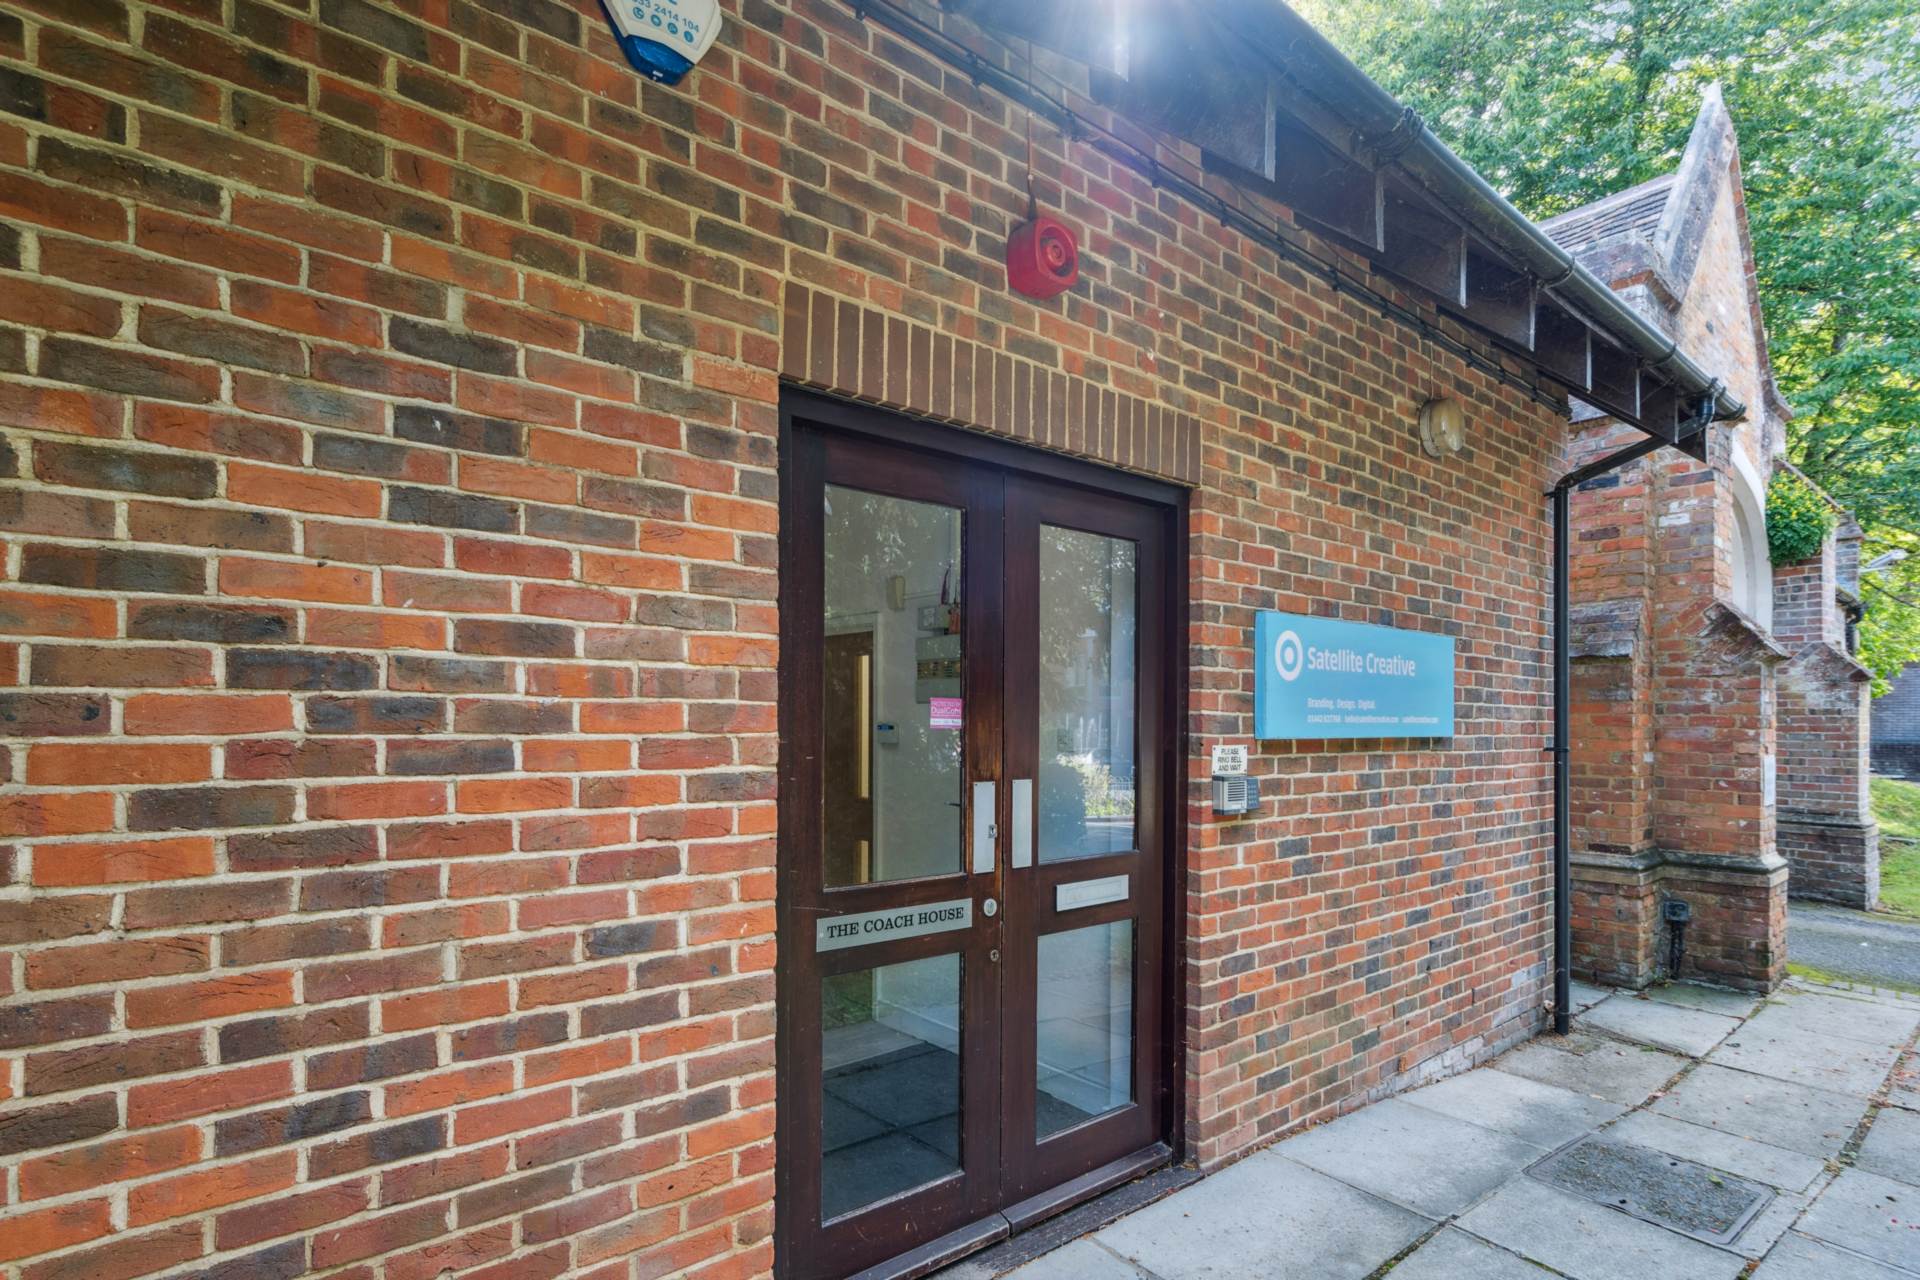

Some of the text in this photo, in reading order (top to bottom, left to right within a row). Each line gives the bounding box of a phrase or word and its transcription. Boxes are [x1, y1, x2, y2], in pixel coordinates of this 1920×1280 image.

[654, 4, 679, 21] 2414
[682, 18, 700, 33] 104
[1307, 647, 1416, 677] Satellite Creative
[1230, 763, 1241, 771] WAIT
[827, 907, 965, 939] THE COACH HOUSE
